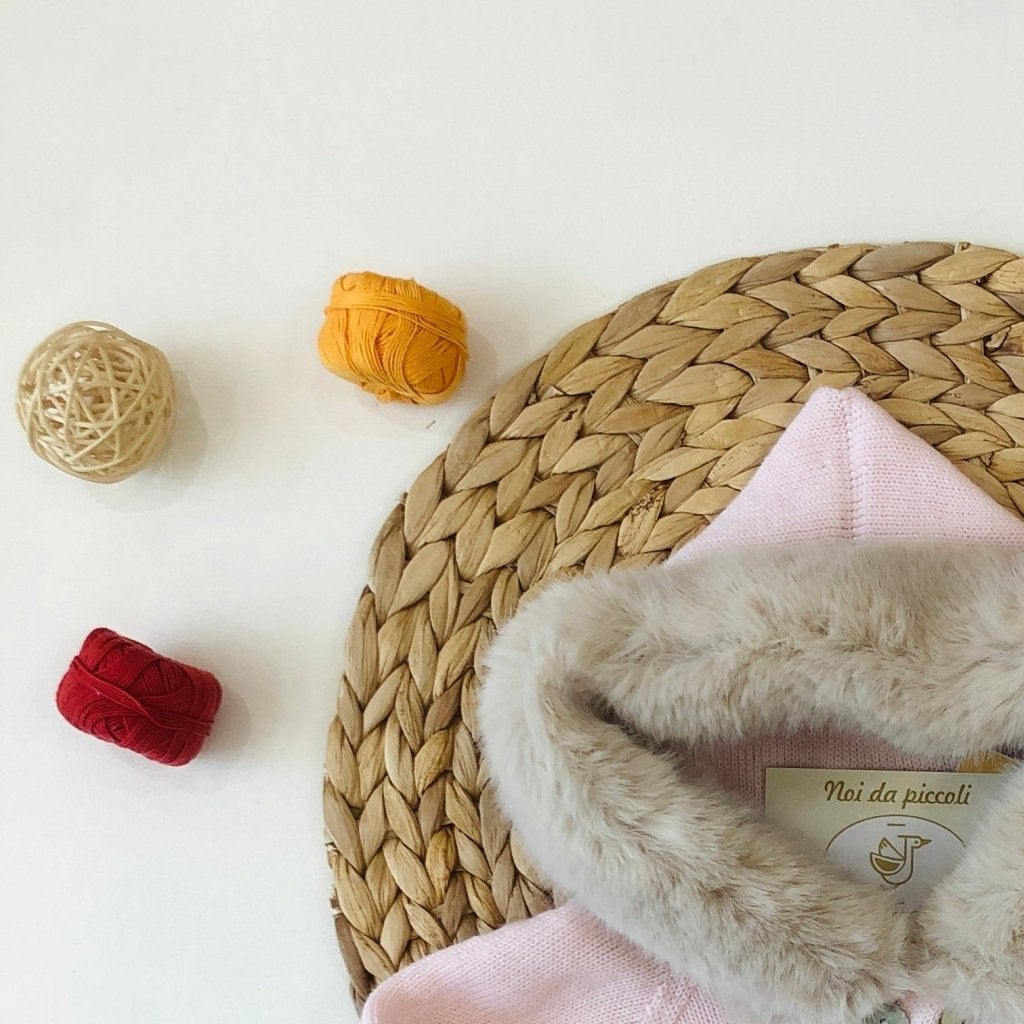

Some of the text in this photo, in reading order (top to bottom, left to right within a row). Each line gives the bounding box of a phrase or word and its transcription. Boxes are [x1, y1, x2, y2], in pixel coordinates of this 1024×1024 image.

[824, 780, 972, 809] Noi da piccoli
